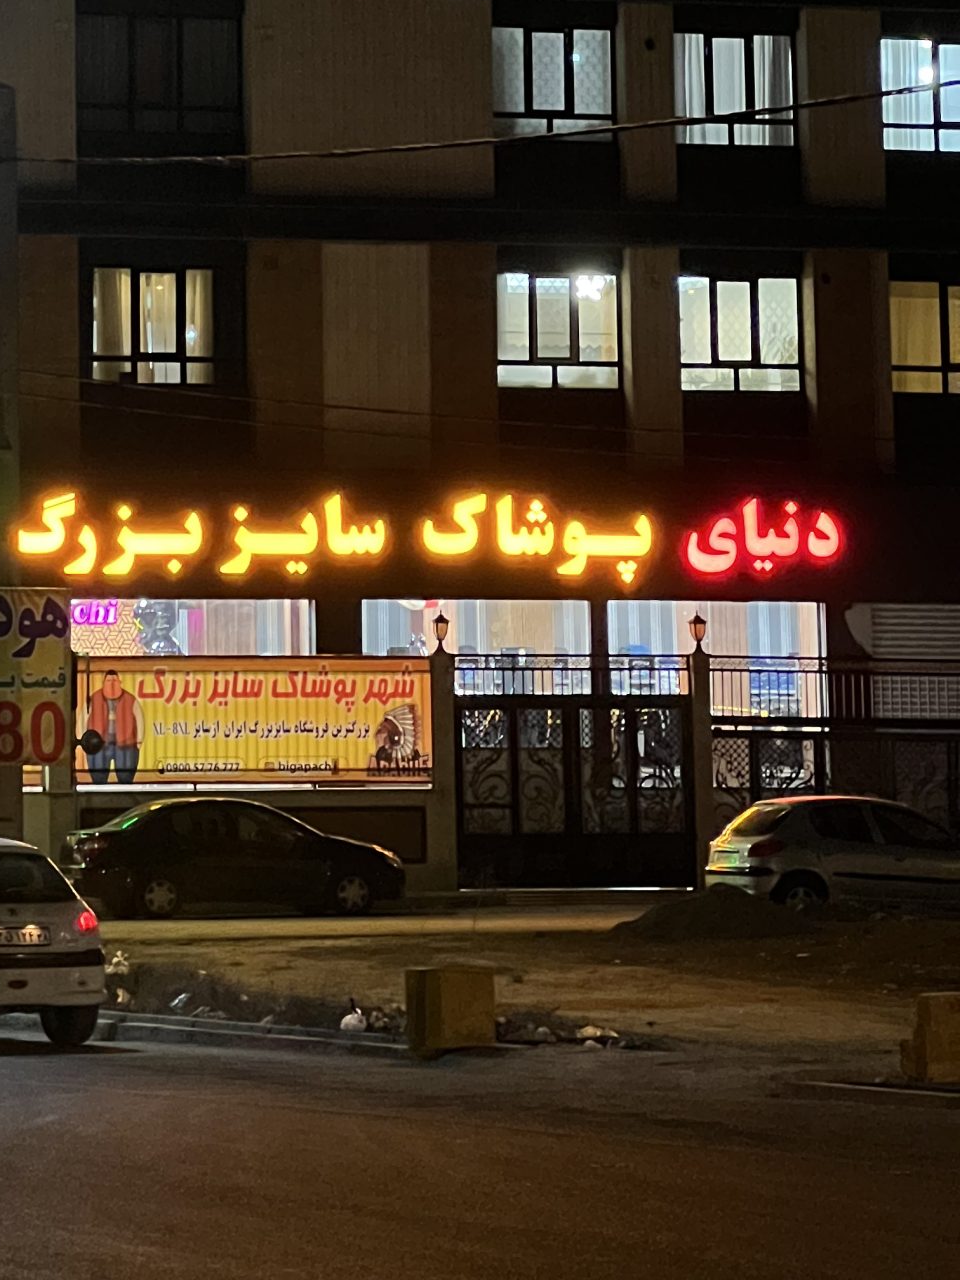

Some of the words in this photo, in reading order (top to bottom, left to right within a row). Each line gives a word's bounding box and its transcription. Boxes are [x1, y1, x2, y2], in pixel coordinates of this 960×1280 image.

[17, 492, 203, 575] بزرگ
[220, 494, 386, 575] سایز
[422, 493, 652, 583] پوشاک
[687, 497, 840, 573] دنیای
[20, 666, 67, 694] قیمت
[137, 668, 202, 707] بزرگ
[207, 671, 264, 707] سایز
[270, 665, 358, 713] پوشاک
[362, 665, 415, 706] شهر
